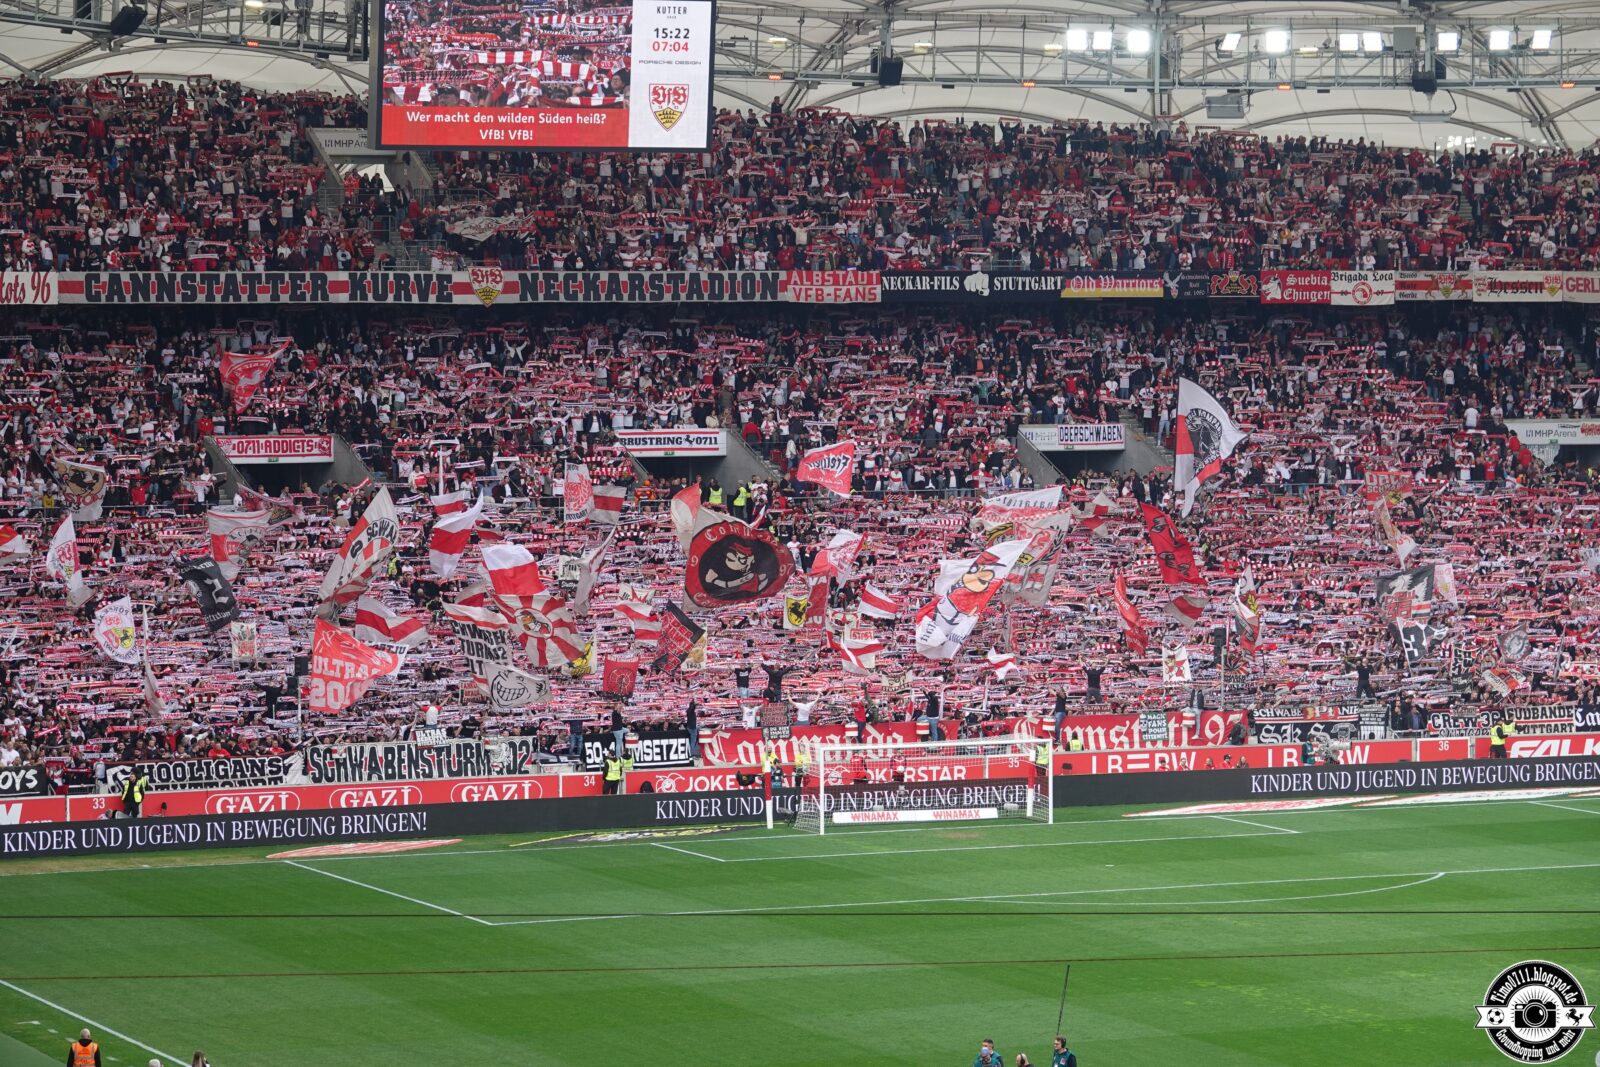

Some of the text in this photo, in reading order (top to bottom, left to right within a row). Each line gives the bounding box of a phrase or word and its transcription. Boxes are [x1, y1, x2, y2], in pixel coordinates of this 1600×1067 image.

[657, 6, 687, 15] KUTTER
[654, 28, 690, 39] 15:22
[652, 41, 689, 52] 07:04
[406, 111, 607, 124] Wer macht den wilden Süden heiß?
[479, 129, 534, 141] VfB! VfB!
[790, 270, 879, 286] ALBSTADT
[882, 275, 1062, 291] NECKAR-FILS STUTTGART
[1070, 275, 1097, 293] Old
[1286, 273, 1328, 286] Suebia
[1331, 271, 1394, 282] Brigada Loca
[1565, 276, 1600, 293] GERL
[0, 271, 51, 304] ots 96
[84, 272, 330, 303] CANNSTATTER
[348, 272, 453, 303] KURVE
[518, 271, 781, 302] NECKARSTADION
[792, 286, 878, 303] VFB-FANS
[1487, 276, 1543, 297] Hessen
[1283, 287, 1330, 303] Ehingen
[695, 436, 718, 445] 0711
[1059, 425, 1123, 443] OBERSCHWABEN
[1534, 429, 1553, 437] MHP
[236, 439, 260, 455] 0711
[263, 439, 314, 454] ADDICTS
[1148, 719, 1167, 728] FANS
[1438, 740, 1450, 751] 36
[309, 740, 531, 783] SCHWABENSTURM 02
[1008, 757, 1020, 768] 35
[136, 757, 284, 784] HOOLIGANS
[1251, 772, 1314, 794] KINDER
[1316, 771, 1352, 790] UND
[1354, 767, 1417, 791] JUGEND
[1420, 768, 1438, 786] IN
[1442, 763, 1531, 786] BEWEGUNG
[583, 775, 595, 787] 34
[92, 797, 105, 809] 33
[656, 796, 723, 820] KINDER
[727, 796, 764, 817] UND
[839, 791, 859, 812] IN
[862, 786, 958, 811] BEWEGUNG
[851, 809, 981, 822] WINAMAX WINAMAX
[4, 811, 428, 853] KINDER UND JUGEND IN BEWEGUNG BRINGEN!
